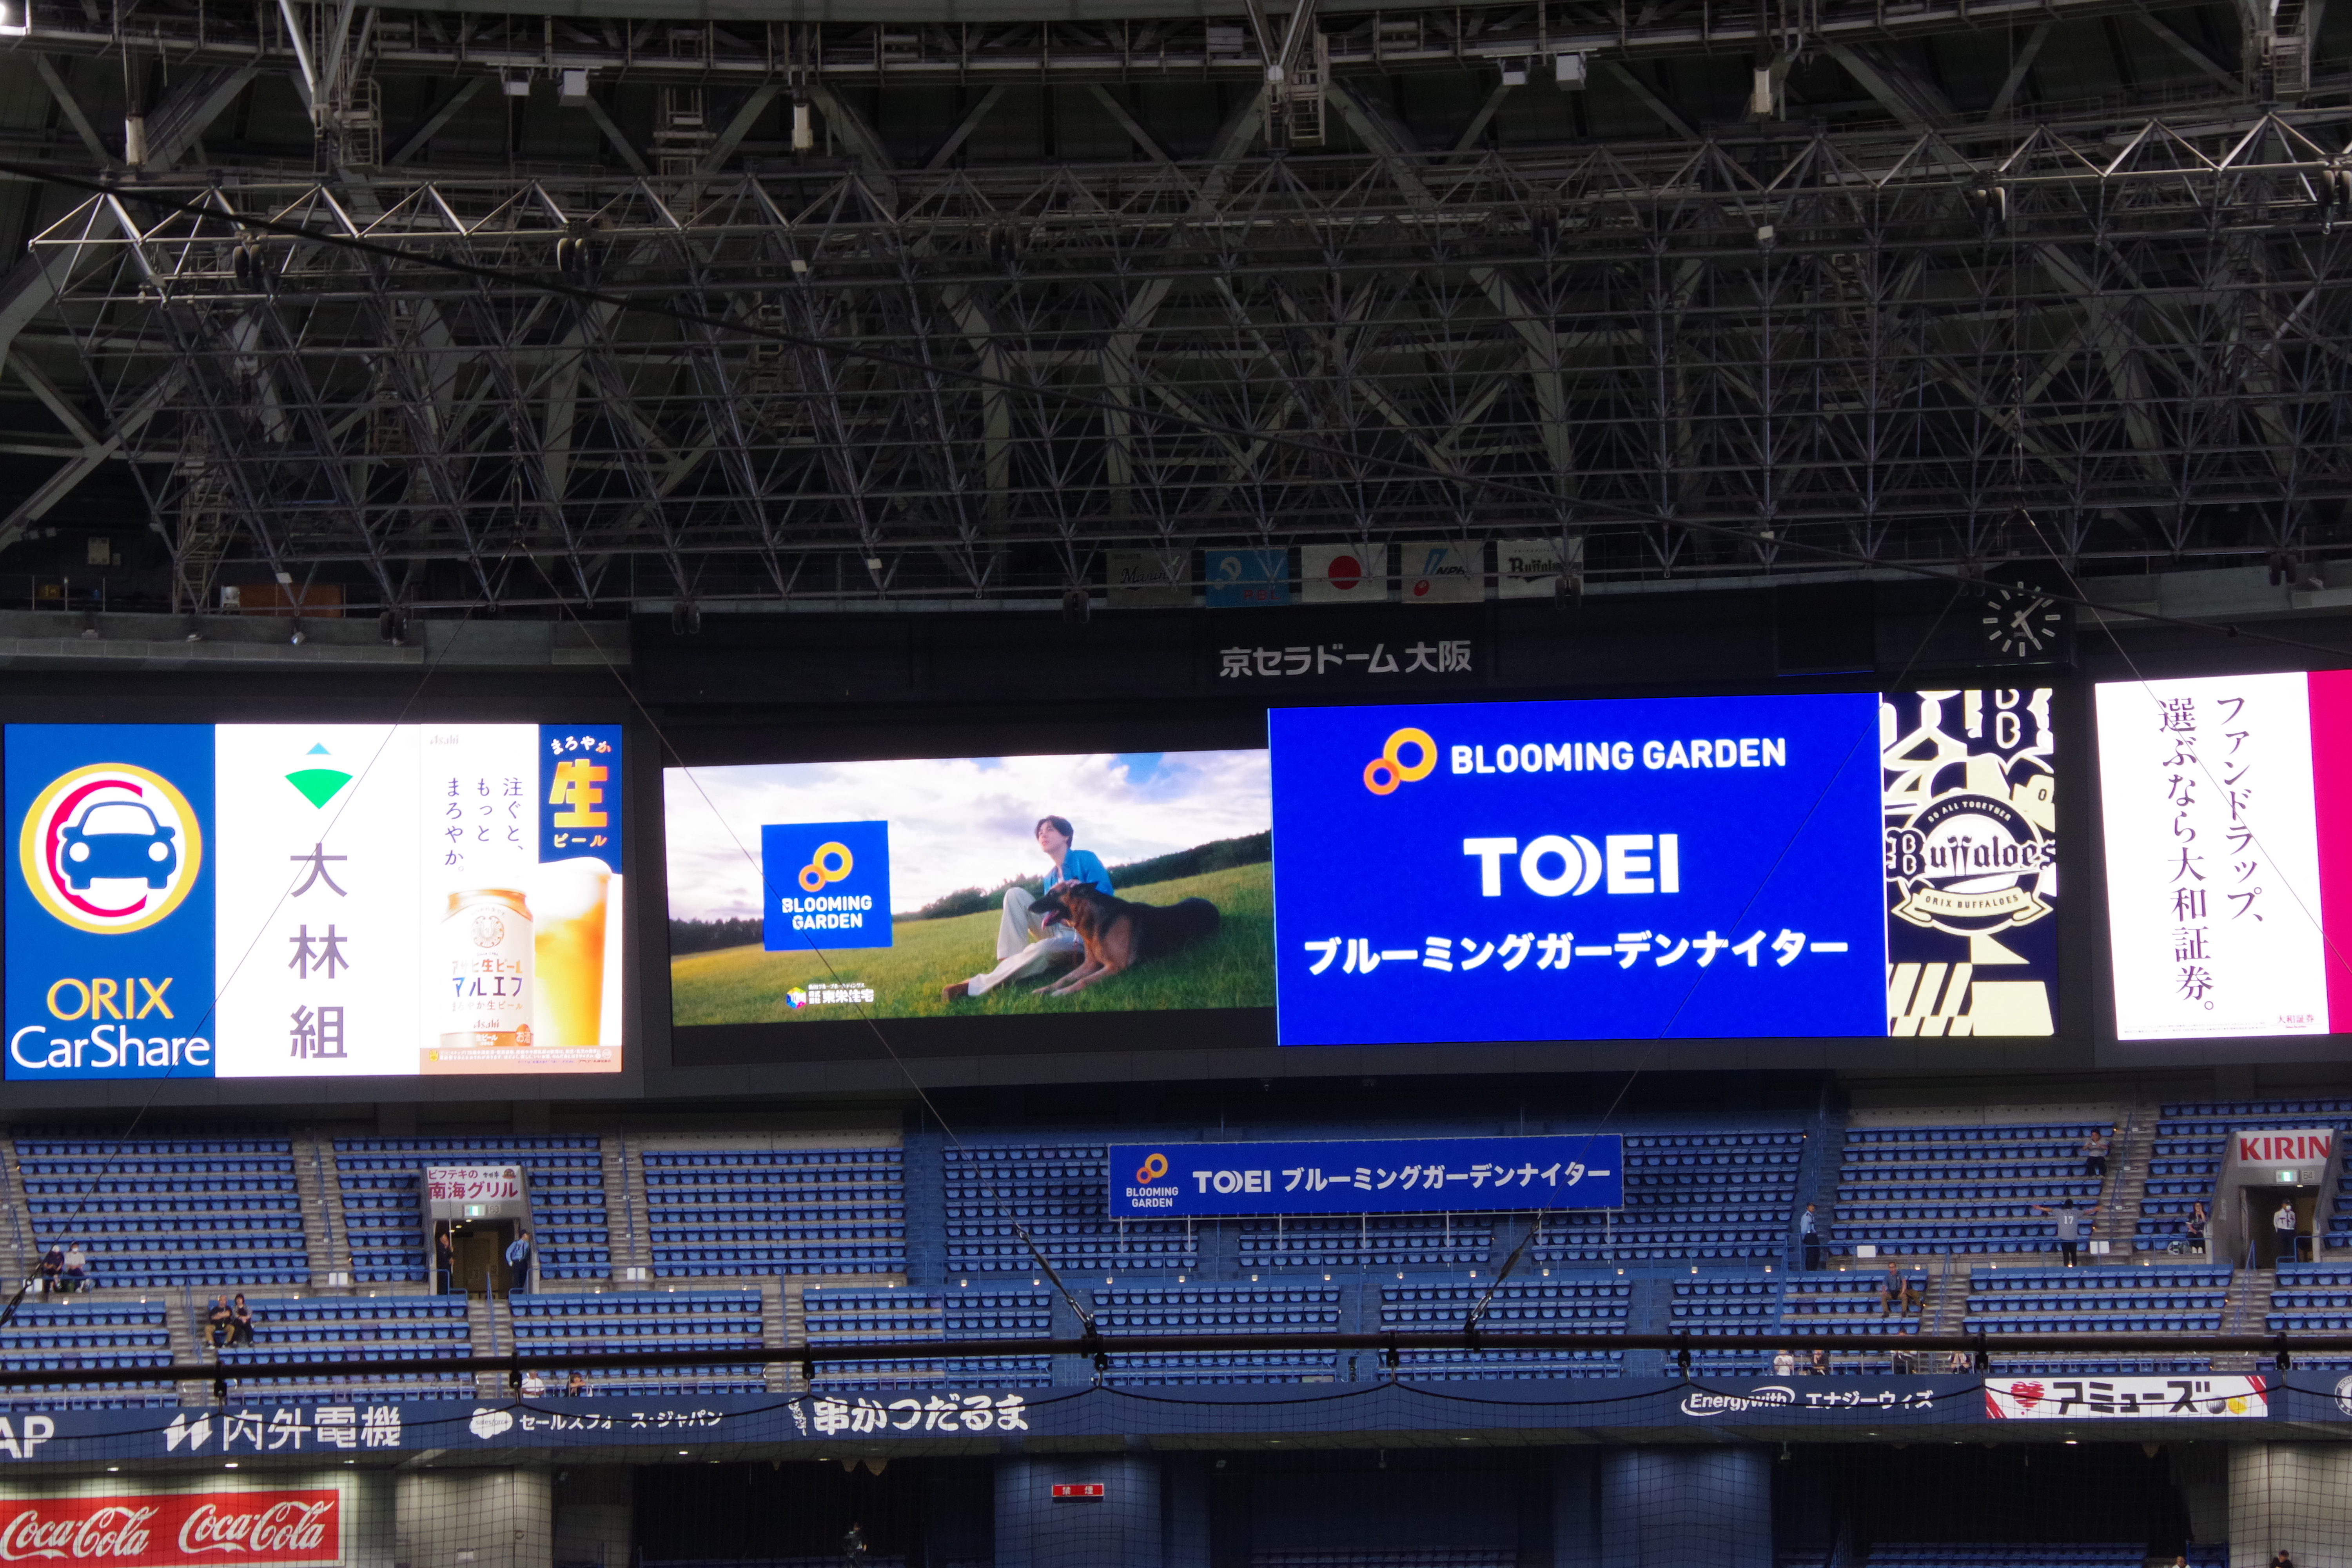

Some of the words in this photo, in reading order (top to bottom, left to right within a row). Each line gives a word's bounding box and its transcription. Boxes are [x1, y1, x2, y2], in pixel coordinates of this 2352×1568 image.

[1243, 589, 1281, 601] PBL
[1219, 640, 1472, 679] 京セラドーム大阪
[550, 736, 612, 755] まろやか
[1452, 741, 1634, 774] BLOOMING
[1642, 738, 1786, 770] GARDEN
[549, 758, 608, 828] 生
[477, 778, 493, 842] もっと
[503, 777, 524, 850] 注ぐと、
[1942, 803, 1959, 815] ALL
[1962, 801, 2011, 822] TOGETHER
[2217, 697, 2263, 922] ファンドラップ、
[445, 777, 464, 872] まろやか。
[554, 833, 608, 848] ビール
[1463, 834, 1680, 897] TOEI
[1886, 829, 2056, 880] Buffaloes
[2158, 697, 2214, 1011] 選ぶなら大和証券。
[782, 895, 872, 914] BLOOMING
[1926, 895, 1952, 908] ORIX
[1957, 894, 2018, 908] BUFFALOES
[792, 913, 863, 930] GARDEN
[288, 842, 350, 1060] 大林組
[1304, 929, 1849, 976] ブルーミングガーデンナイター
[47, 977, 174, 1021] ORIX
[452, 976, 523, 998] マルエフ
[822, 988, 874, 1004] 東栄住宅
[473, 1019, 500, 1029] Asahi
[2277, 1014, 2314, 1024] 大和証券
[10, 1024, 210, 1069] CarShare
[515, 1031, 531, 1044] お酒
[2240, 1136, 2332, 1161] KIRIN
[428, 1169, 478, 1180] ビフテキの
[1192, 1169, 1271, 1194] TOEI
[1282, 1161, 1610, 1192] ブルーミングガーデンナイター
[2303, 1171, 2313, 1180] 64
[428, 1181, 519, 1200] 南海グリル
[1126, 1186, 1178, 1198] BLOOMING
[1132, 1197, 1173, 1208] GARDEN
[490, 1205, 499, 1214] 63
[2063, 1216, 2074, 1225] 17
[1690, 1392, 1787, 1411] Energywith
[2053, 1381, 2211, 1415] アミューズ
[813, 1394, 1029, 1436] 串かつだるま
[223, 1406, 401, 1452] 内外電機
[1, 1505, 160, 1561] Coca-Cola
[178, 1500, 335, 1553] Coca-Cola
